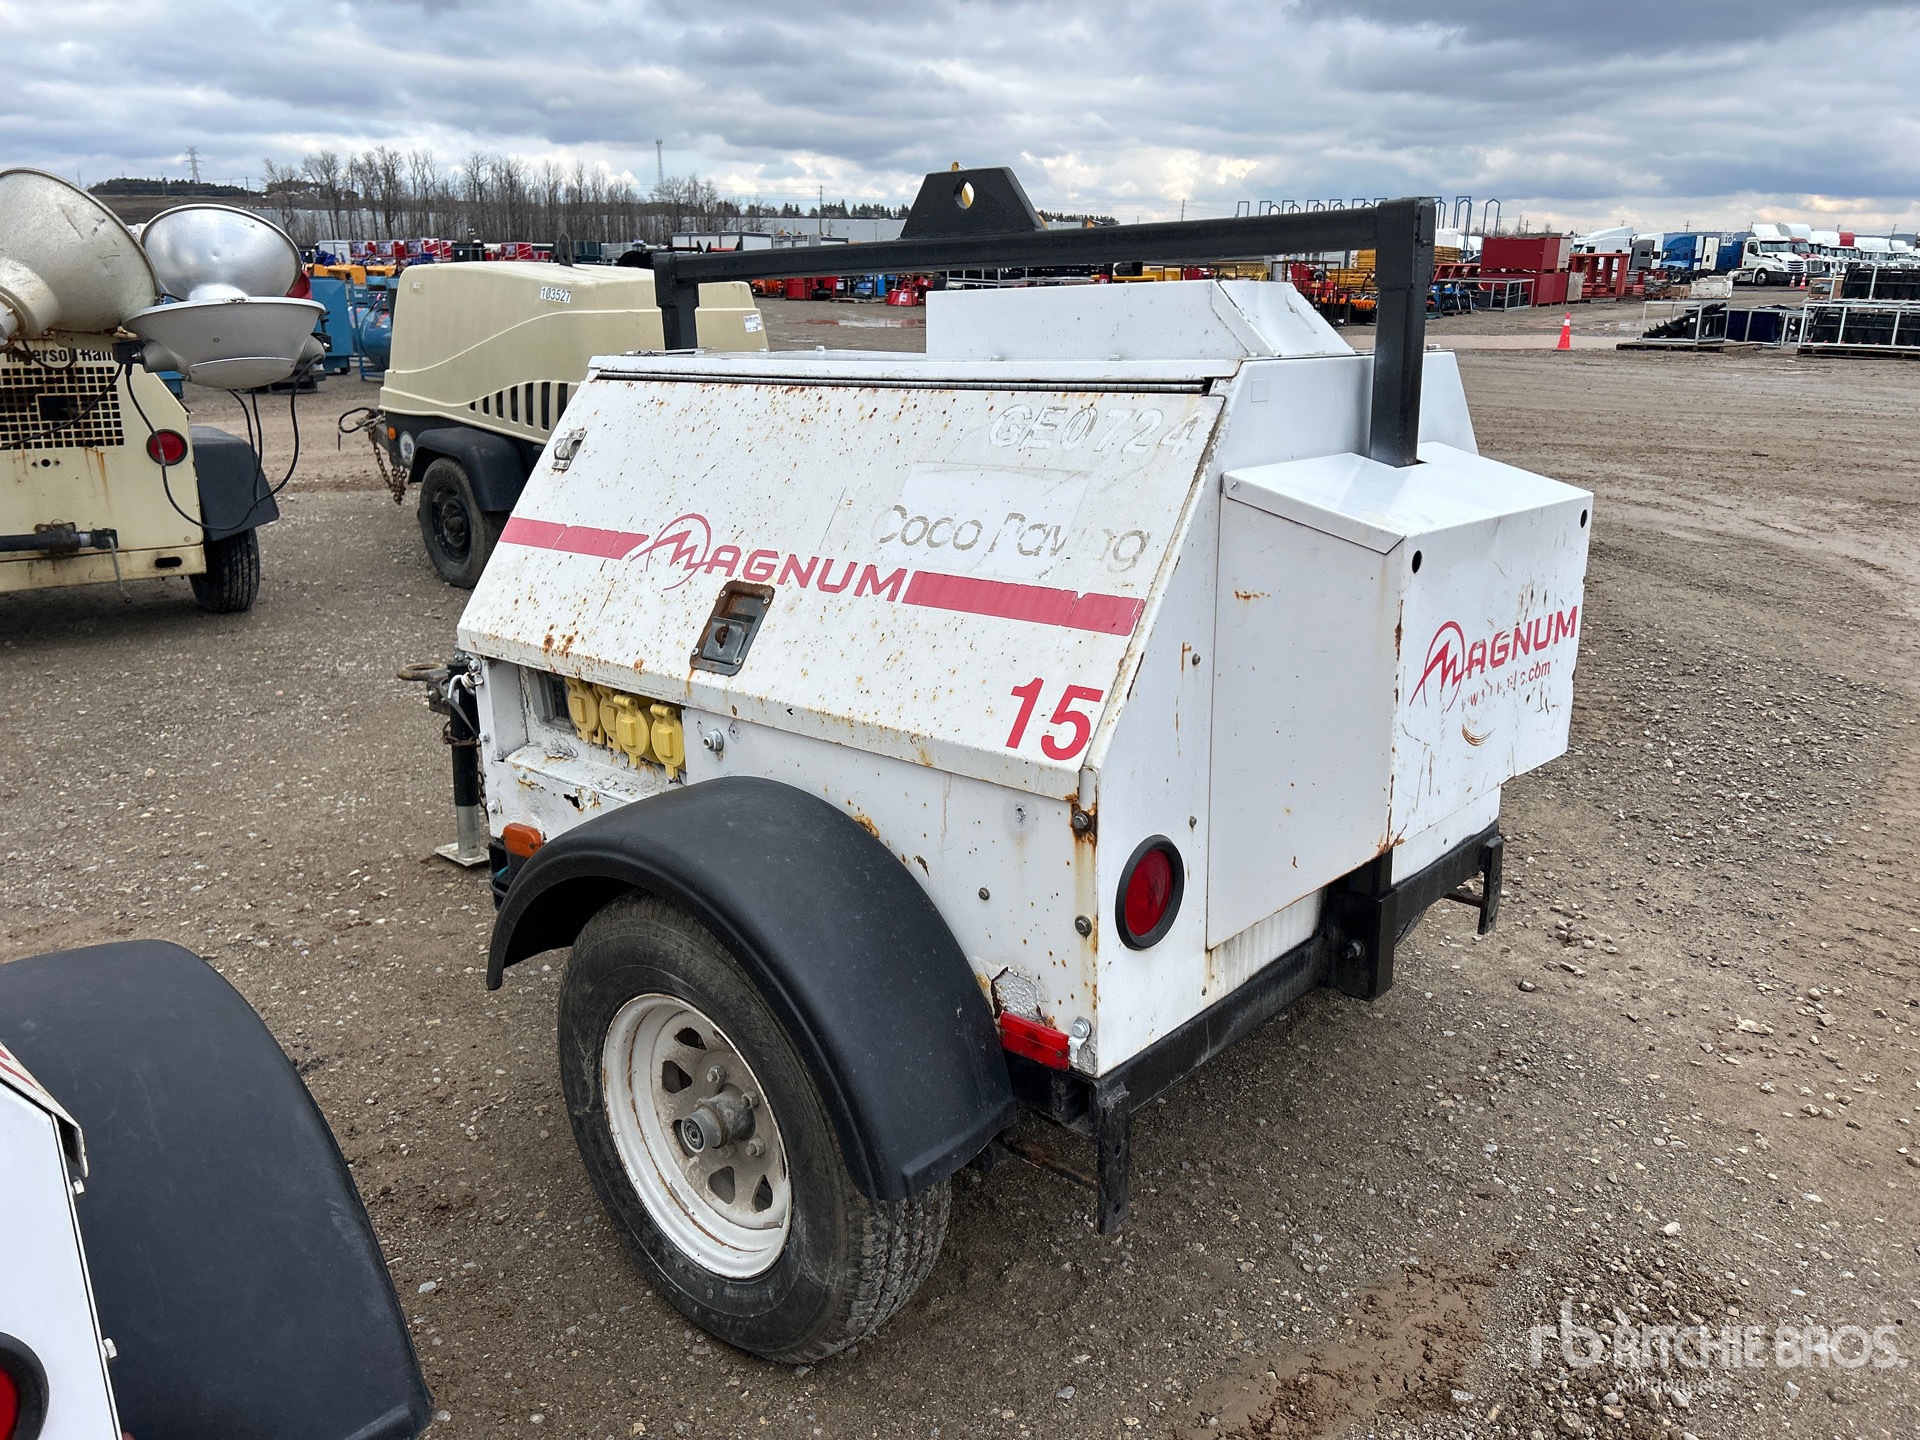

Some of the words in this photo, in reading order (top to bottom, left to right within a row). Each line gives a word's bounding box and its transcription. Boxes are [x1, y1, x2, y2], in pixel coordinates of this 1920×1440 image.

[541, 287, 571, 302] 103527
[989, 404, 1204, 455] GE0724
[631, 512, 907, 603] MAGNUM
[871, 505, 983, 551] Coco
[1409, 606, 1577, 712] MAGNUM
[1006, 677, 1103, 761] 15
